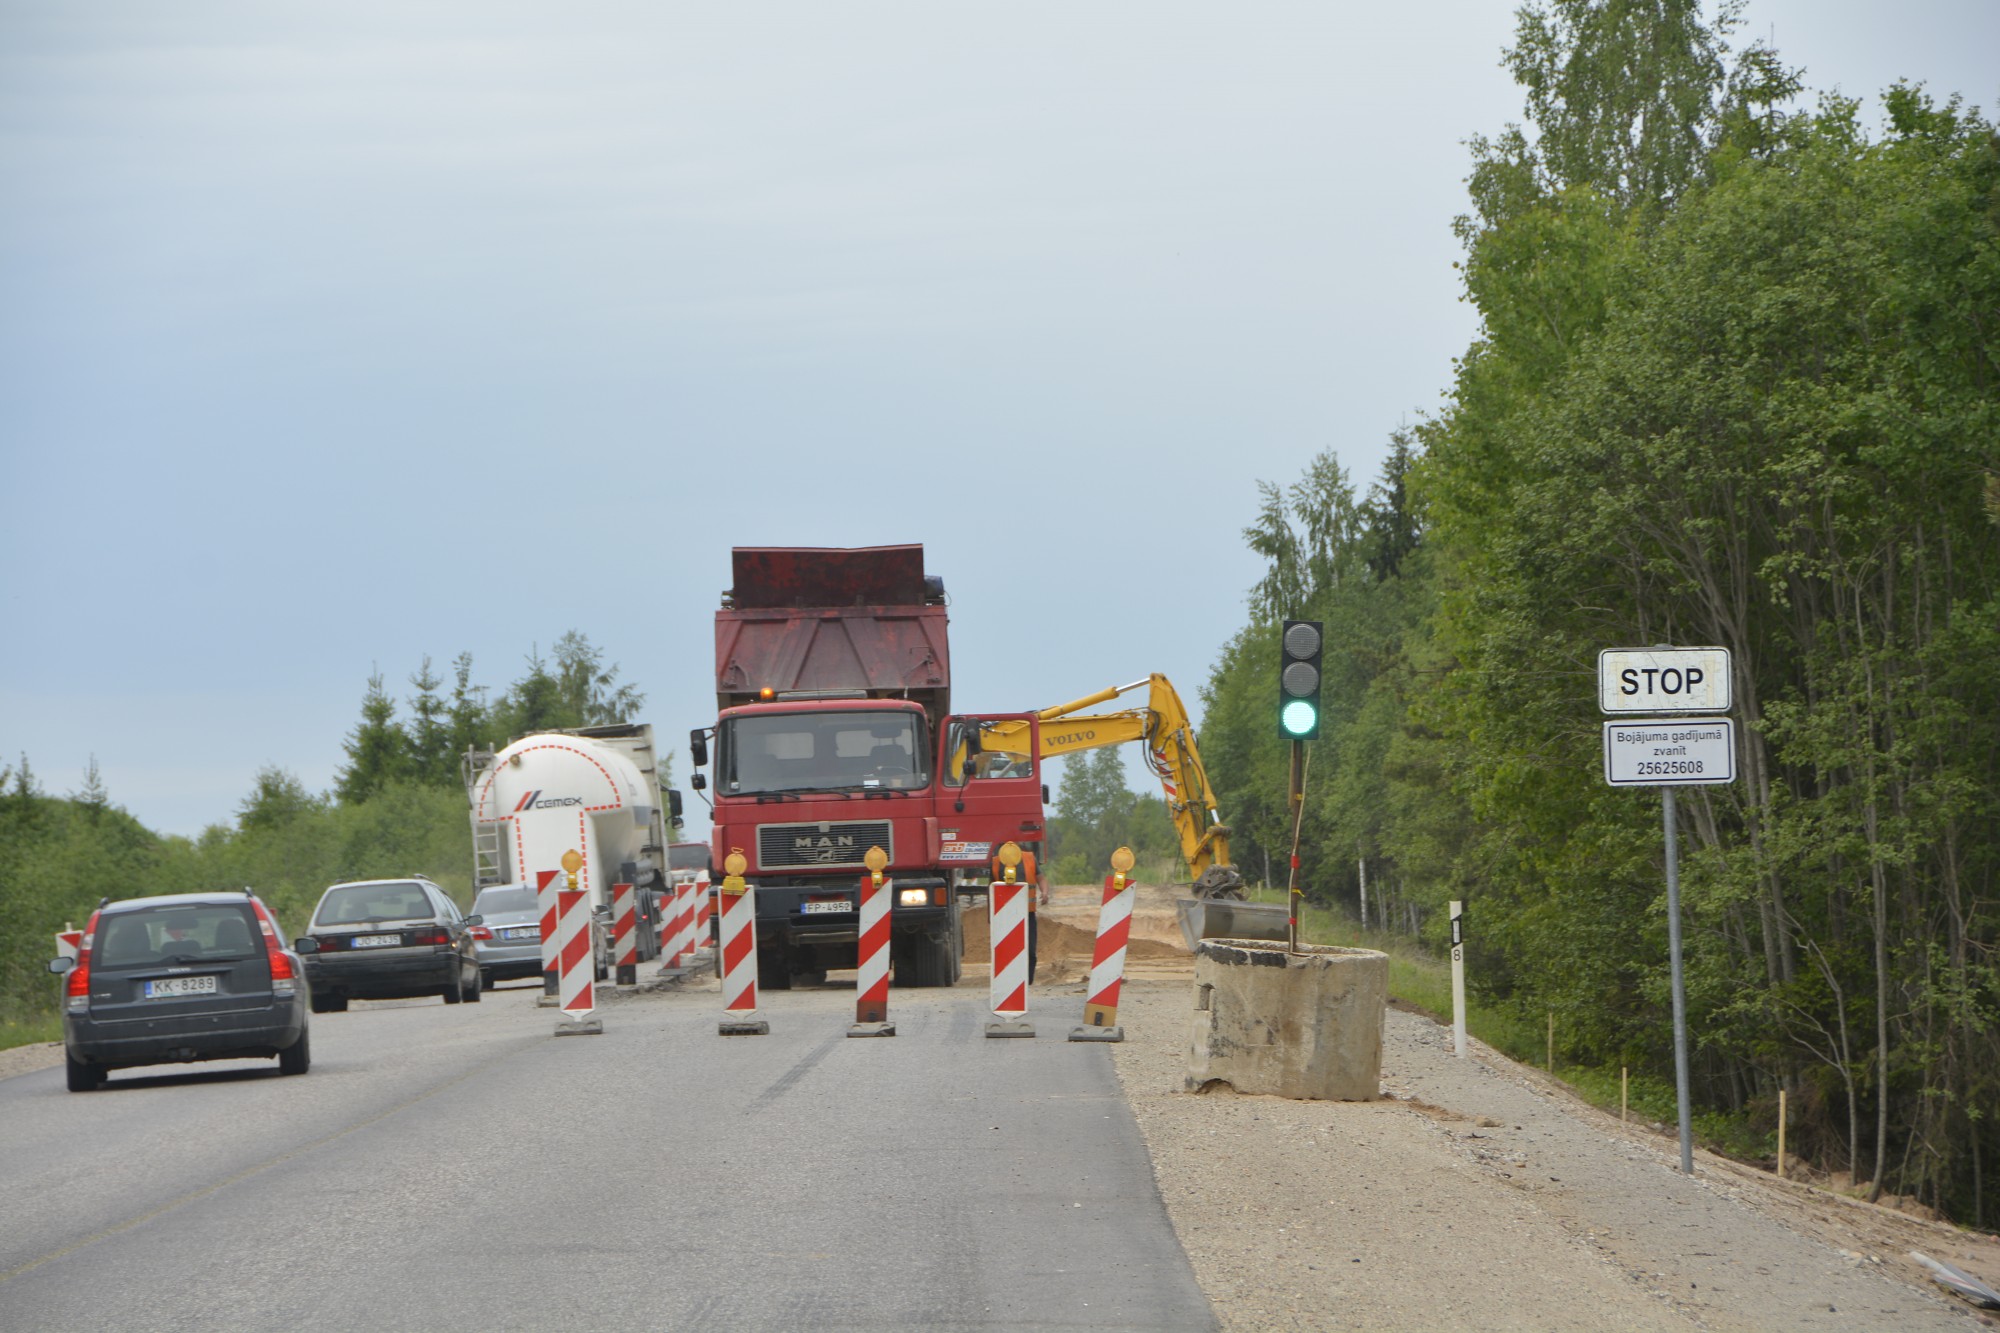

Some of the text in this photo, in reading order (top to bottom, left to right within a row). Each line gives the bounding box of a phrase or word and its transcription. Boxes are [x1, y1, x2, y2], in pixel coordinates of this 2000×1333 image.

[1620, 667, 1704, 696] STOP
[1045, 730, 1096, 747] VOLVO
[1617, 729, 1722, 745] Bojājuma gadījumā
[1653, 746, 1687, 756] zvanīt
[1637, 760, 1704, 775] 25625608
[536, 797, 582, 809] CEMEX
[795, 836, 853, 847] MAN
[1453, 949, 1461, 961] 8
[155, 977, 214, 993] KK-8289
